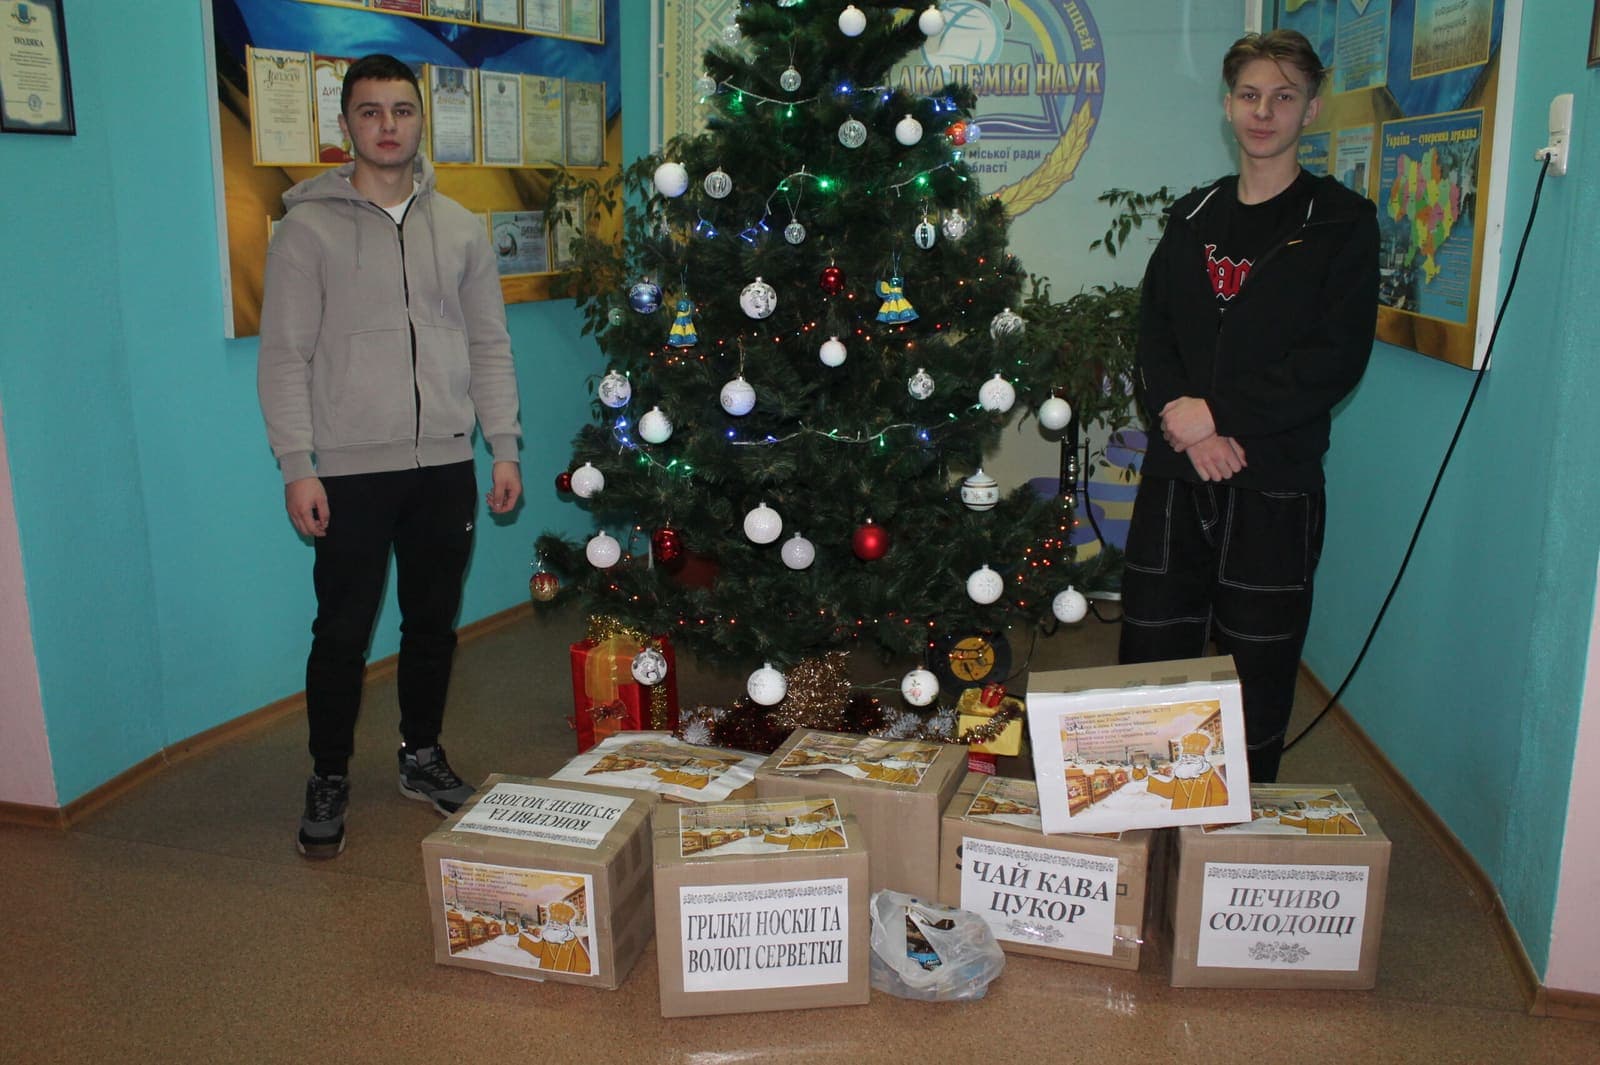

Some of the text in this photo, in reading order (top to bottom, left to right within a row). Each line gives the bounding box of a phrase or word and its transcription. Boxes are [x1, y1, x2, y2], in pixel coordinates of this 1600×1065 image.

[1063, 1, 1096, 50] ЛІЦЕЙ
[901, 63, 1030, 96] АКАДЕМІЯ
[1035, 62, 1101, 94] НАУК
[969, 147, 1010, 159] міської
[1013, 150, 1041, 160] ради
[483, 793, 621, 821] ЗГУЩЕНЕ МОЛОКО
[489, 808, 591, 831] КОНСЕРВИ ТА
[973, 860, 1109, 902] ЧАЙ КАВА
[989, 891, 1086, 924] ЦУКОР
[1228, 887, 1340, 910] ПЕЧИВО
[686, 905, 841, 941] ГРІЛКИ НОСКИ ТА
[1208, 911, 1357, 937] СОЛОДОЩІ
[687, 939, 843, 974] ВОЛОГІ СЕРВЕТКИ
